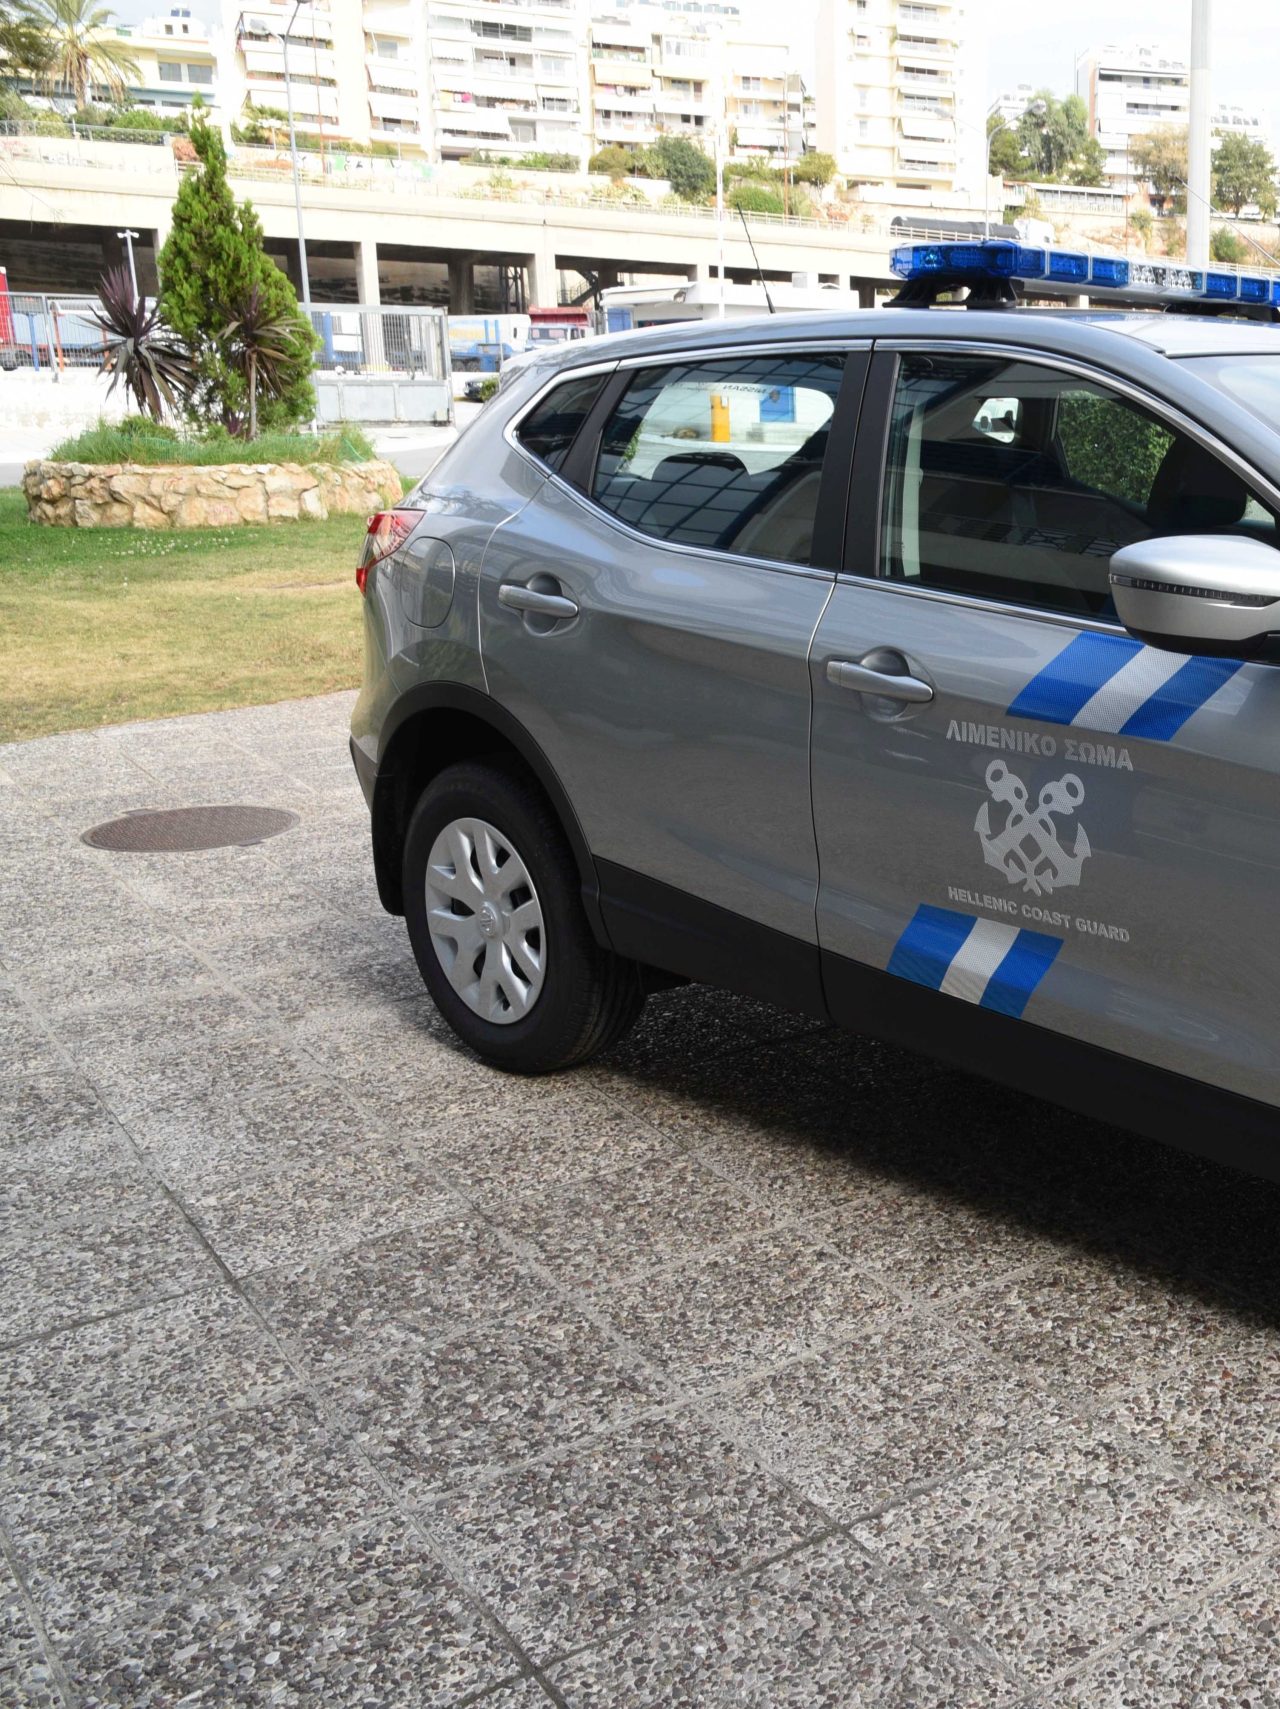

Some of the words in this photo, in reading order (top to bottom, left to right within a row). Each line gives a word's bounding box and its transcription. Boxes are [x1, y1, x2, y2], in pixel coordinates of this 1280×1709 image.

[946, 719, 1057, 757] ΛΙΜΕΝΙΚΟ
[1064, 738, 1134, 772] ΣΩΜΑ
[947, 886, 1018, 916] HELLENIC
[1021, 904, 1071, 929] COAST
[1075, 918, 1130, 943] GUARD
